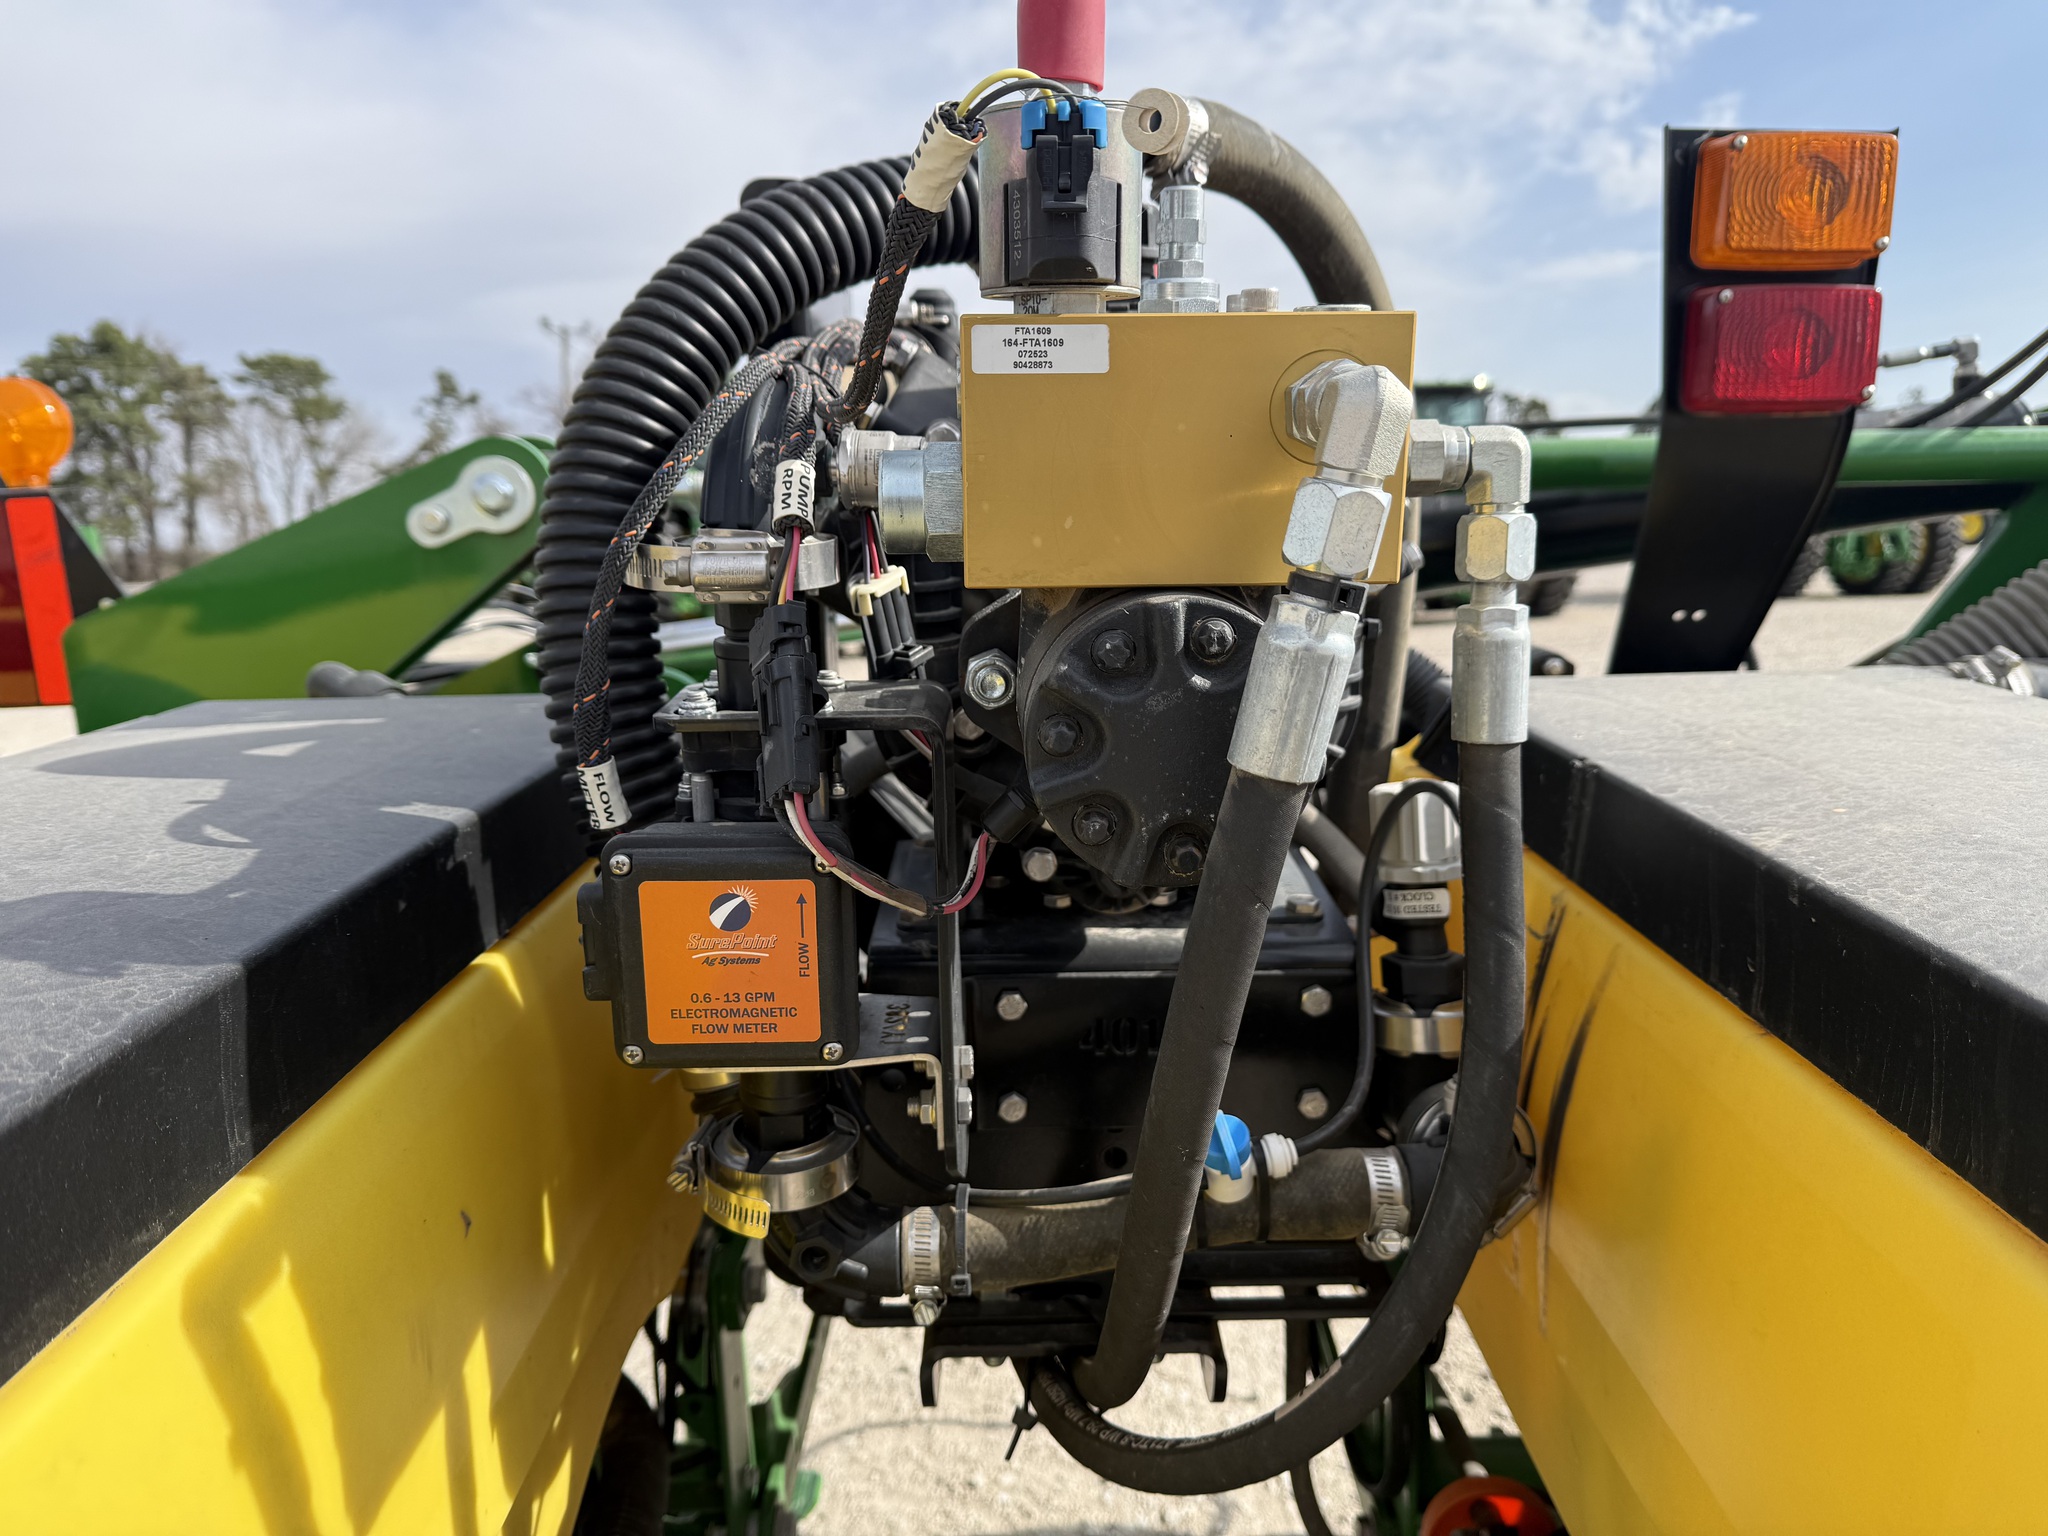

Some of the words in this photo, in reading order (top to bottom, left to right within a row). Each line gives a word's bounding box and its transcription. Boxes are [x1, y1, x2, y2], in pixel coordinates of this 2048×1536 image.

[1014, 326, 1052, 335] FTA1609
[1002, 338, 1064, 347] 164-FTA1609
[1018, 350, 1048, 358] 072523
[1013, 360, 1053, 369] 90428873
[781, 468, 794, 510] RPM
[796, 463, 811, 518] PUMP
[593, 772, 615, 822] FLOW
[686, 932, 778, 950] SurePoint
[702, 956, 718, 966] Ag
[718, 956, 761, 966] Systems
[798, 942, 810, 977] FLOW
[690, 992, 712, 1003] 0.6
[723, 992, 741, 1003] 13
[744, 991, 775, 1002] GPM
[670, 1006, 798, 1019] ELECTROMAGNETIC
[691, 1023, 729, 1034] FLOW
[733, 1022, 778, 1033] METER
